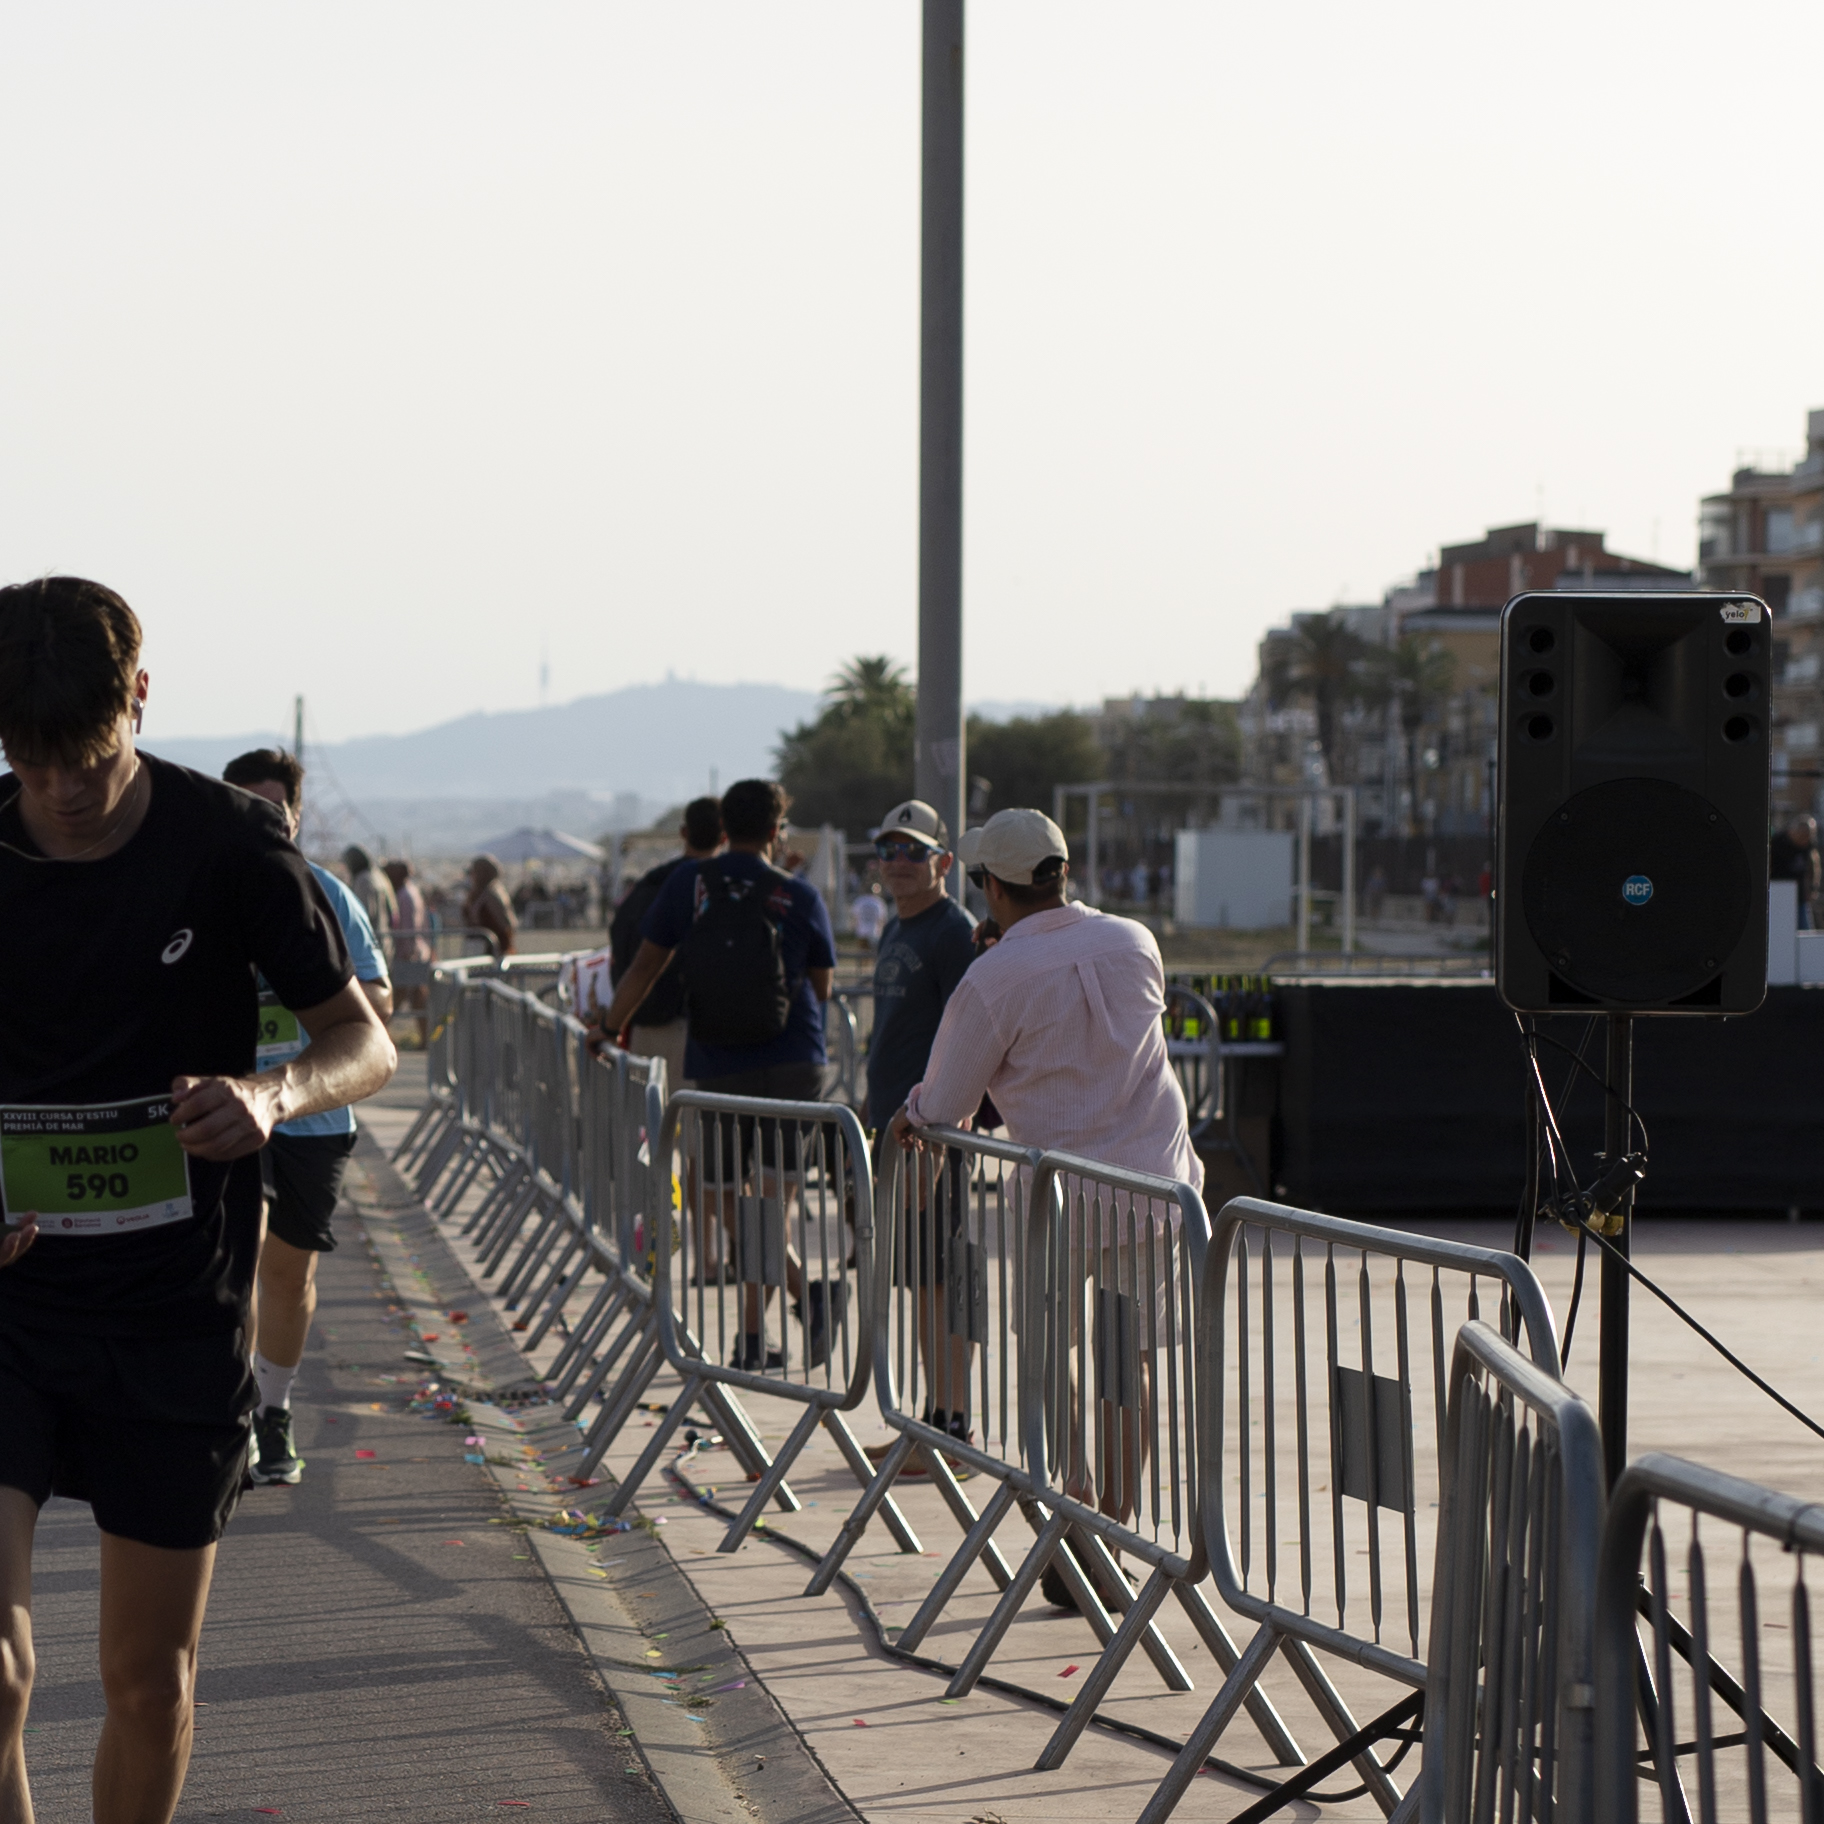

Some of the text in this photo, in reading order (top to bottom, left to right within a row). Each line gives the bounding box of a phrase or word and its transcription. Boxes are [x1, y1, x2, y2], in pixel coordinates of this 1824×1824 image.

[1626, 883, 1650, 896] RCF
[2, 1110, 119, 1121] XXVIII CURSA D'ESTIU
[147, 1103, 169, 1119] 5K
[45, 1122, 59, 1130] DE
[62, 1122, 85, 1130] MAR
[49, 1142, 139, 1166] MARIO
[66, 1172, 130, 1201] 590
